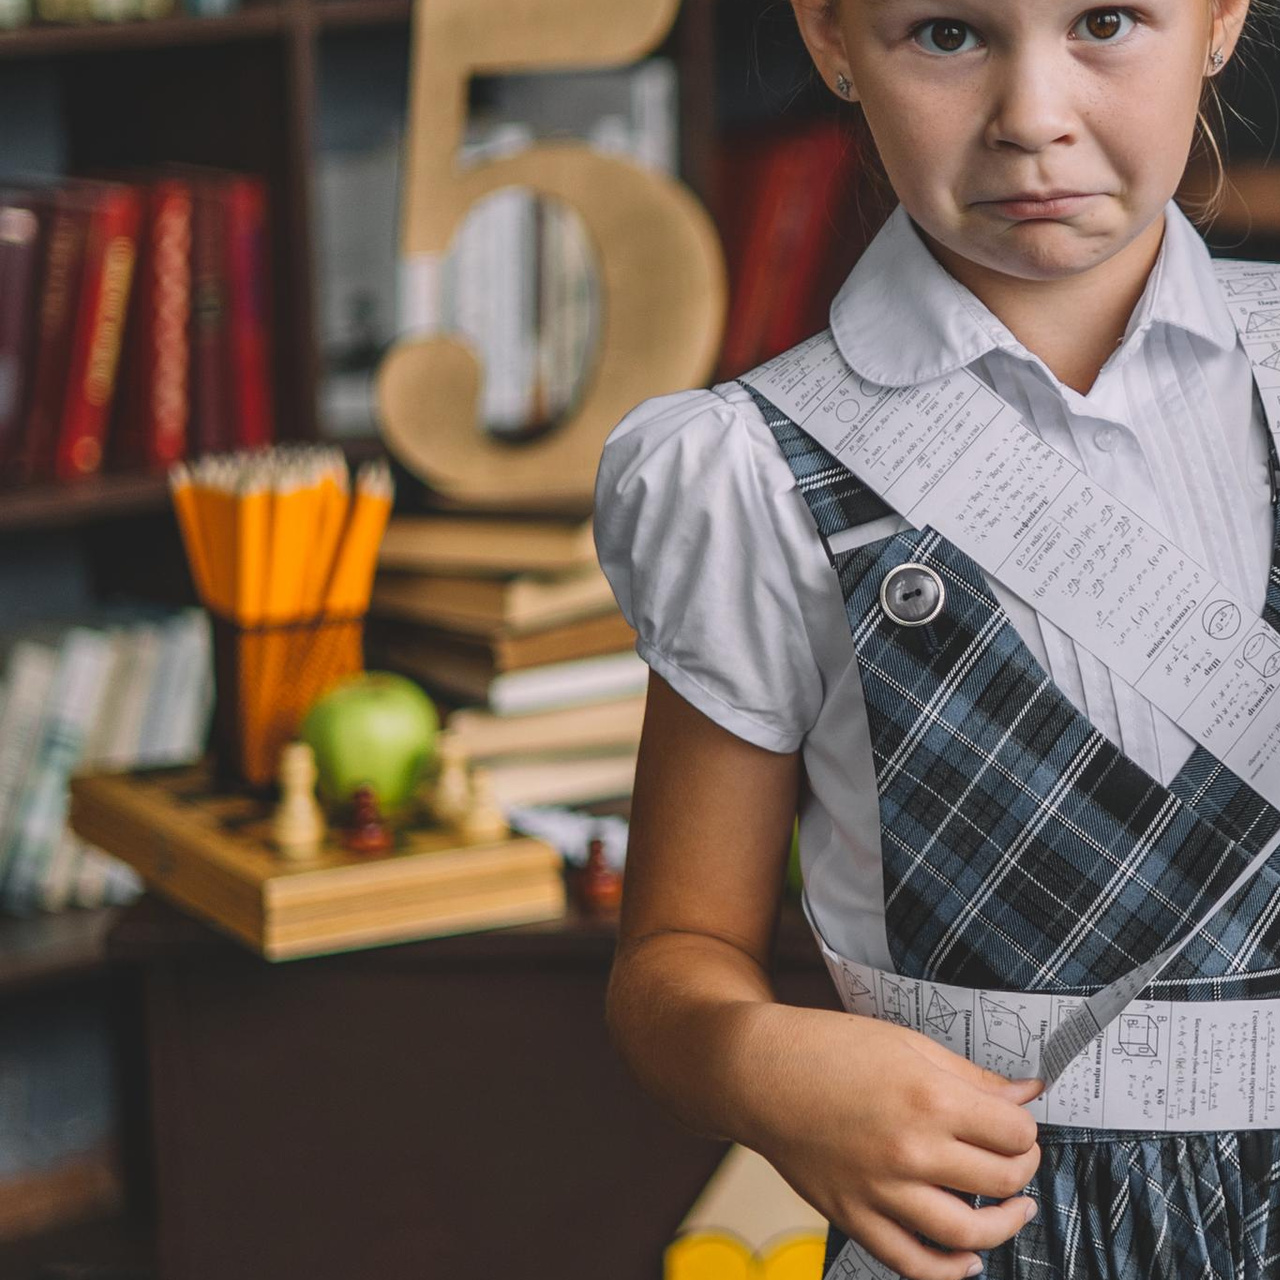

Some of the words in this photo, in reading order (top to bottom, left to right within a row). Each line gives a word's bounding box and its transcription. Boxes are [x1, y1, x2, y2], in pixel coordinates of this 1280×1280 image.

[1010, 494, 1050, 540] Логарифмы
[1201, 656, 1221, 677] Шар
[1248, 1009, 1260, 1075] Геометрическая
[1153, 1088, 1165, 1105] Куб
[1246, 1077, 1256, 1123] прогрессия
